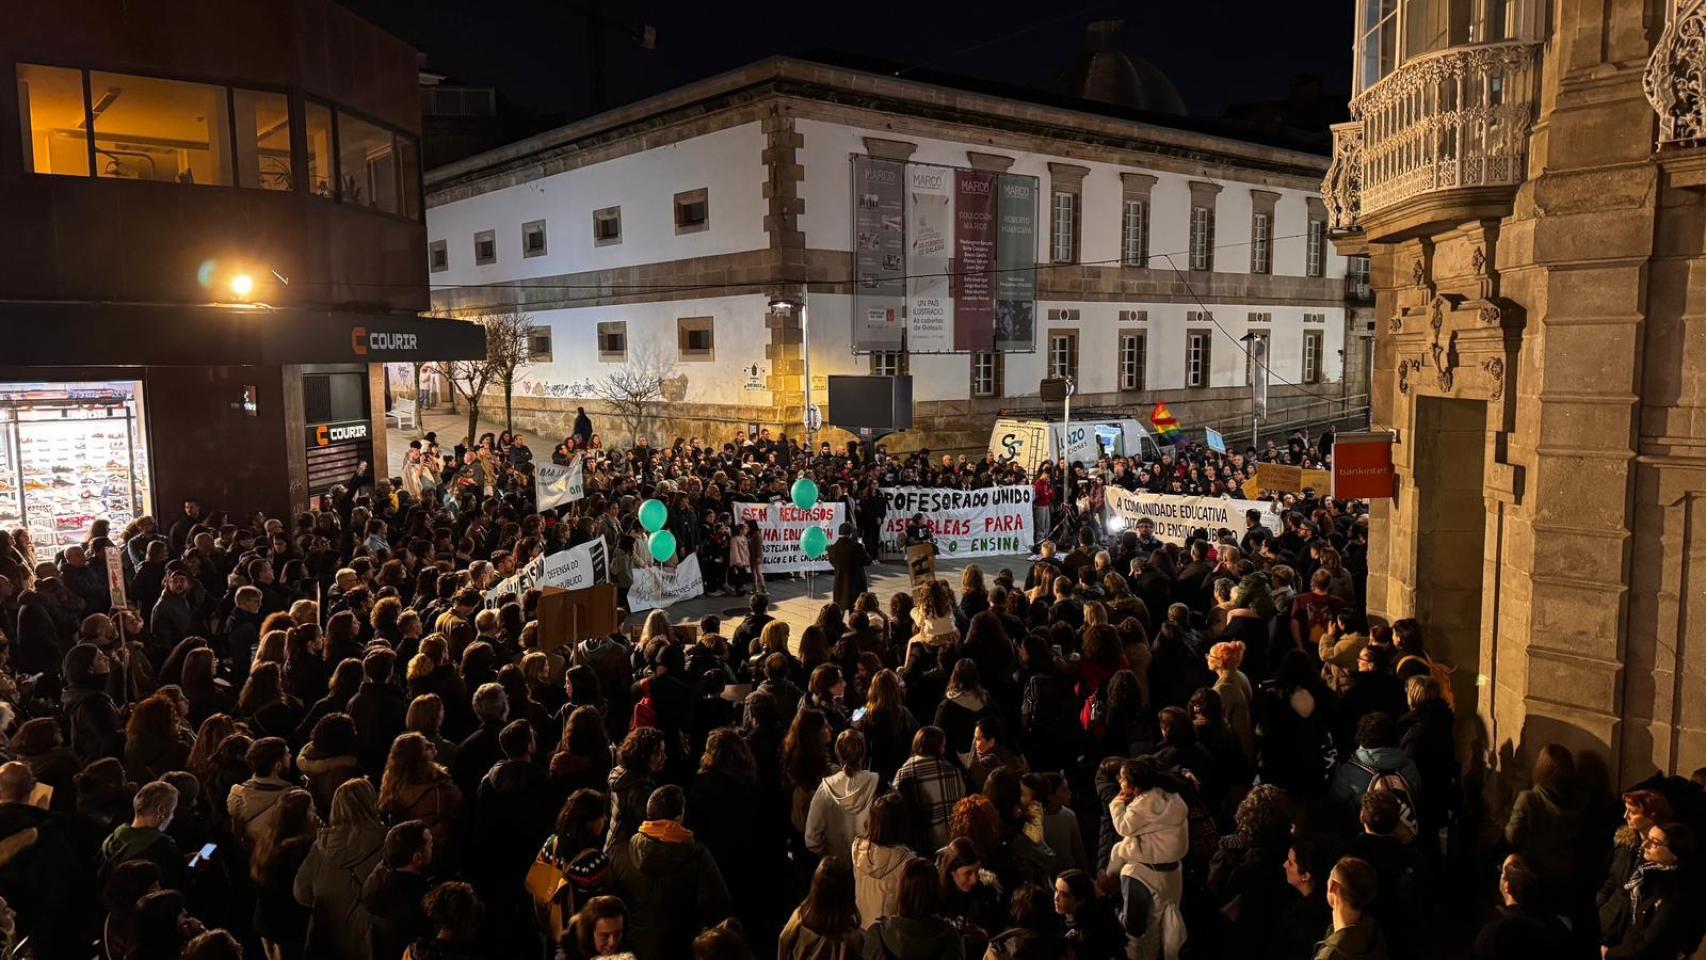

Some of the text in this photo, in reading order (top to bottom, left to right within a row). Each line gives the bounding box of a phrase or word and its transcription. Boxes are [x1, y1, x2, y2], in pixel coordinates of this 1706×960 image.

[913, 174, 942, 187] MARCO
[961, 180, 989, 193] MARCO
[1003, 185, 1030, 197] MARCO
[917, 299, 926, 307] UN
[913, 307, 944, 316] ILUSTRADO
[370, 333, 417, 350] COURIR
[330, 425, 367, 440] COURIR
[1339, 466, 1388, 476] bankinter
[992, 488, 1030, 505] UNIDO
[741, 507, 834, 521] SEN RECURSOS
[1116, 497, 1122, 510] A
[1124, 499, 1178, 518] COMUNIDADE
[1180, 504, 1228, 523] EDUCATIVA
[984, 513, 1024, 532] PARA
[949, 540, 958, 552] O
[971, 537, 1020, 552] ENSINO
[547, 559, 579, 580] DEFENSA DO
